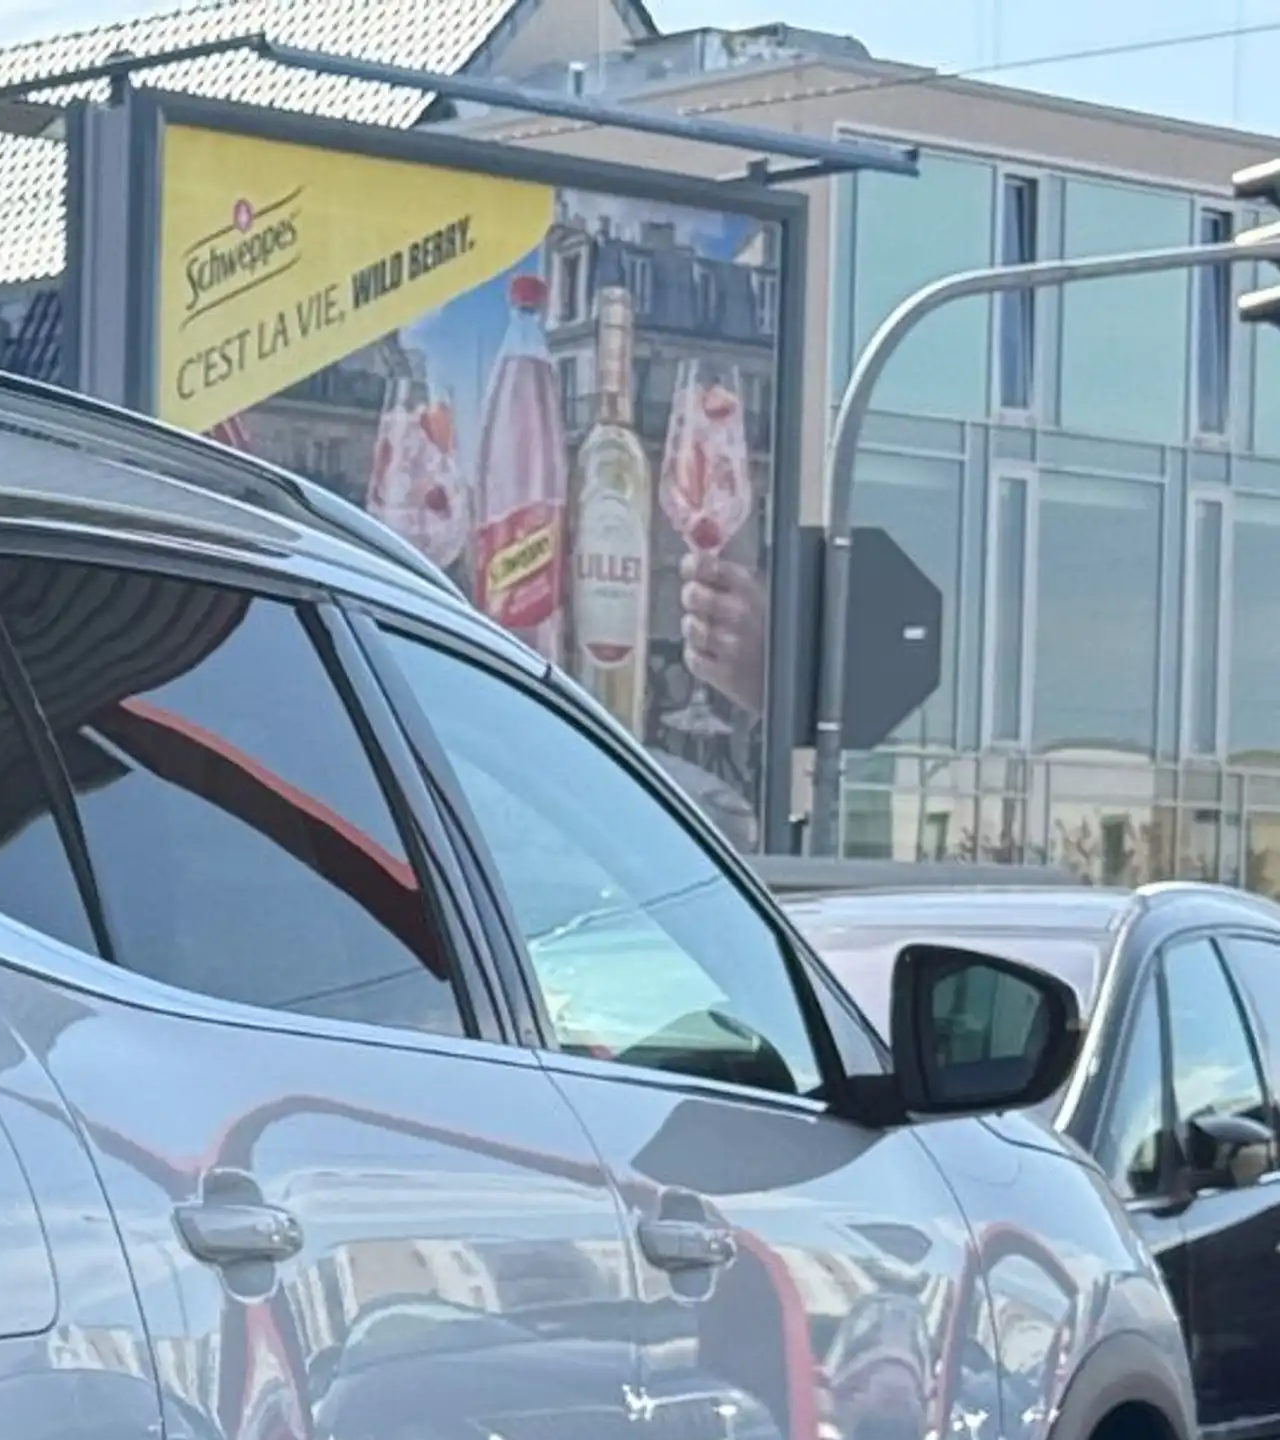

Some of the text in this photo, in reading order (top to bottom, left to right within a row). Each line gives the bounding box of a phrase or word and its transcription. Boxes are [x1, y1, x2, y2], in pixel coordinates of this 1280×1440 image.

[176, 212, 476, 400] C'EST LA VIE, WILD BERRY.
[185, 216, 299, 312] Schweppes
